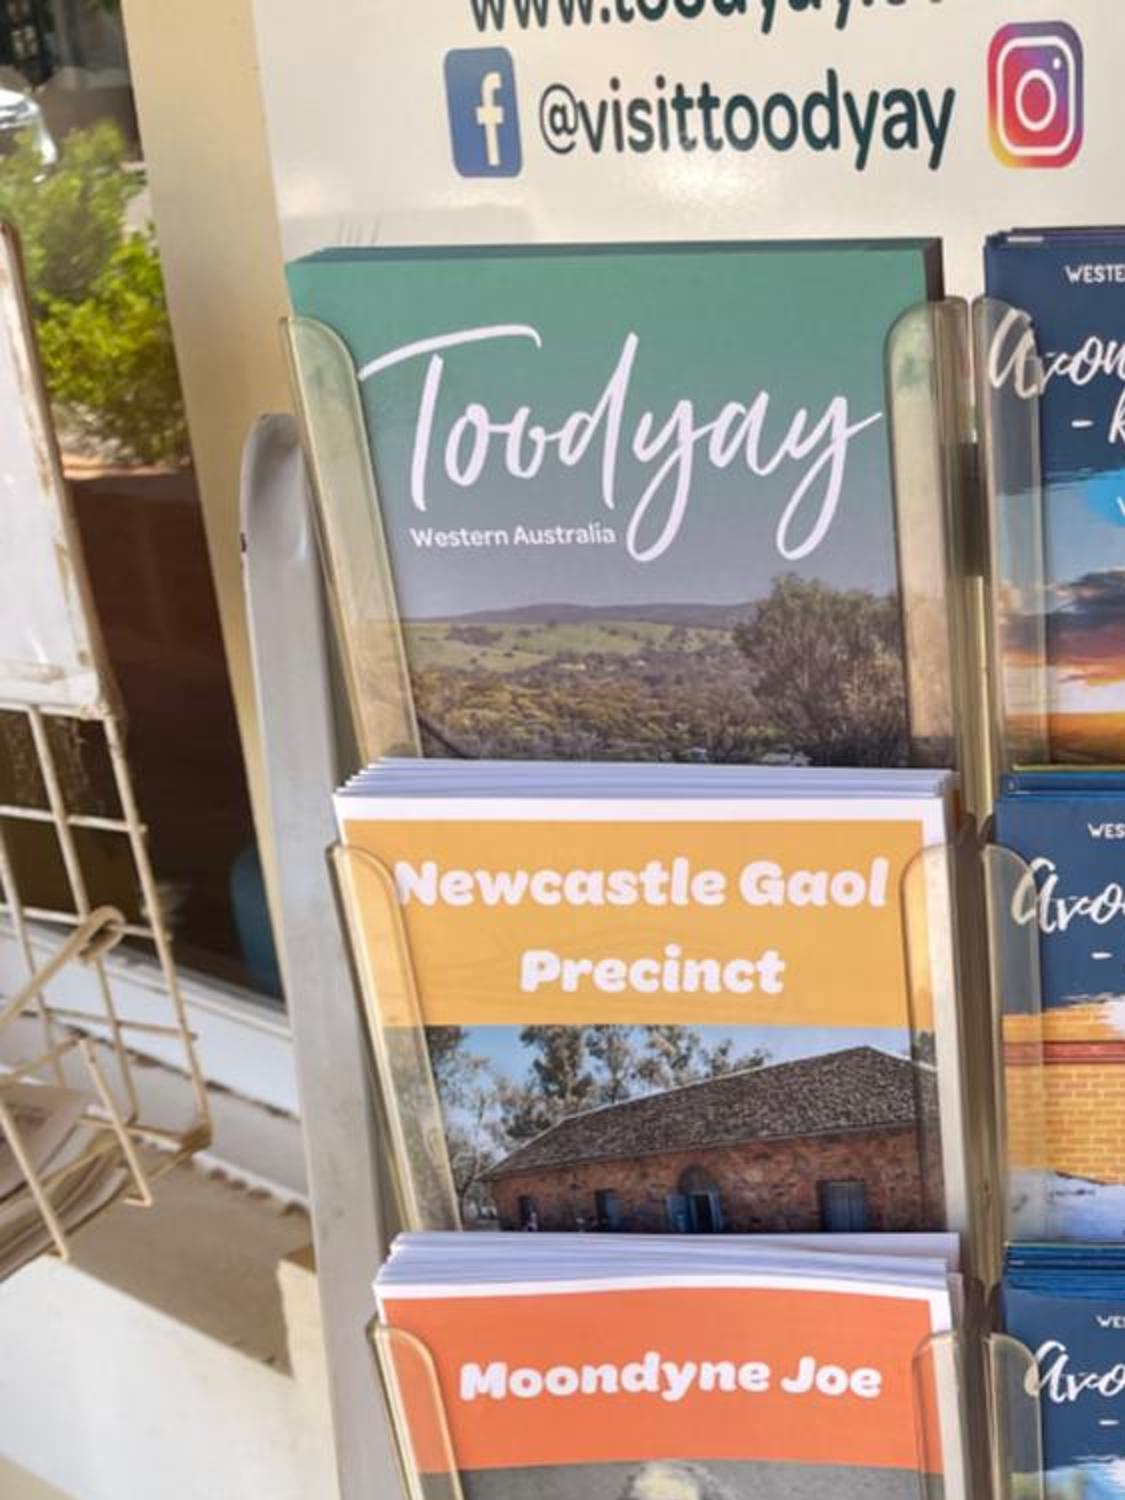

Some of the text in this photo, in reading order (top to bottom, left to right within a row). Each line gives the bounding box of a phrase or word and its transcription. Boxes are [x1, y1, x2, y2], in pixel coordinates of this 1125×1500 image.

[540, 68, 956, 171] @visittoodyay
[360, 324, 882, 561] Toodyay
[410, 523, 616, 549] Western Australia
[394, 856, 890, 907] Newcastle Gaol
[520, 944, 786, 995] Precinct
[460, 1351, 882, 1402] Moondyne Joe
